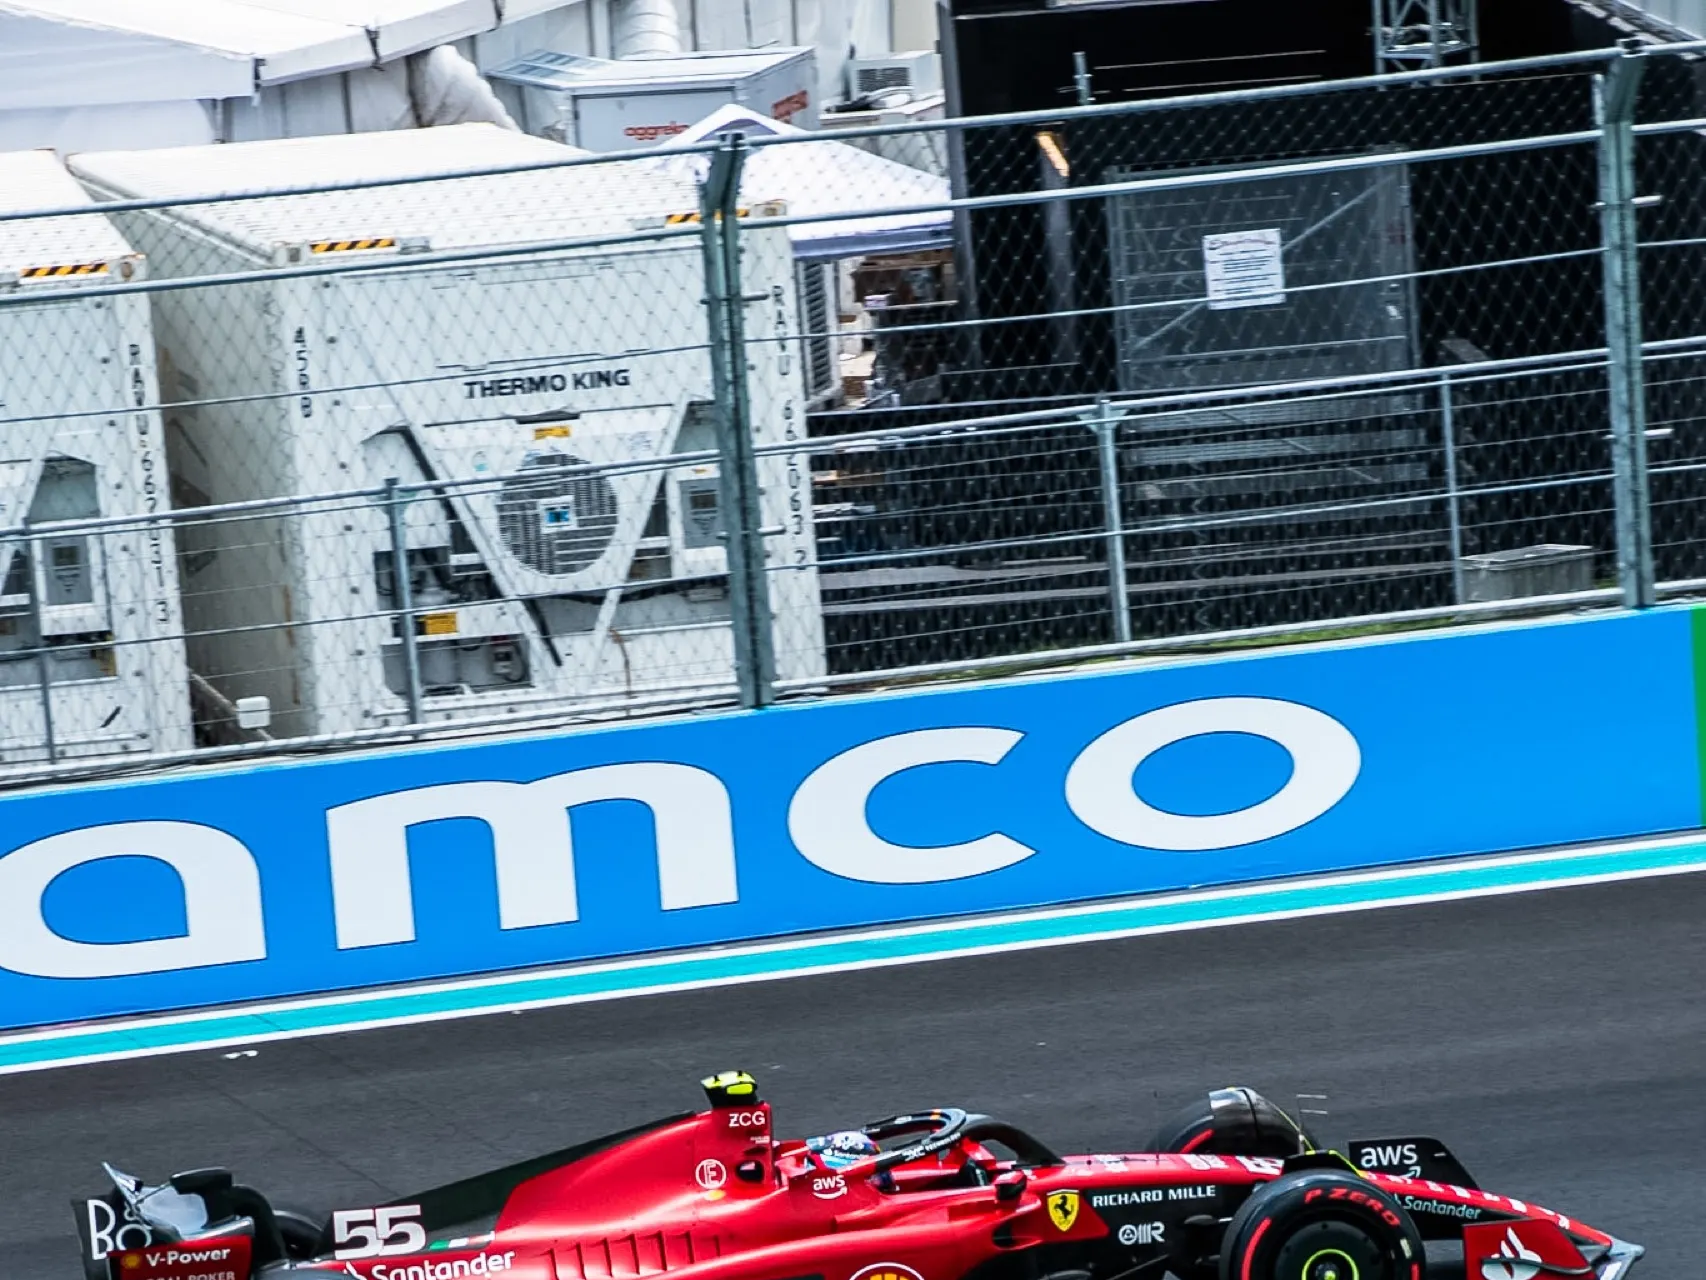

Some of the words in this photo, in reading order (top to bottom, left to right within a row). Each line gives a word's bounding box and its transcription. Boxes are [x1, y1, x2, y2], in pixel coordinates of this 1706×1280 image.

[465, 373, 567, 399] THERMO
[573, 368, 631, 391] KING
[1360, 1144, 1418, 1168] aws
[813, 1174, 846, 1191] aws
[1093, 1189, 1163, 1208] RICHARD
[1168, 1185, 1216, 1200] MILLE
[1403, 1196, 1482, 1220] Santander
[333, 1204, 426, 1260] 55
[146, 1249, 231, 1267] V-Power
